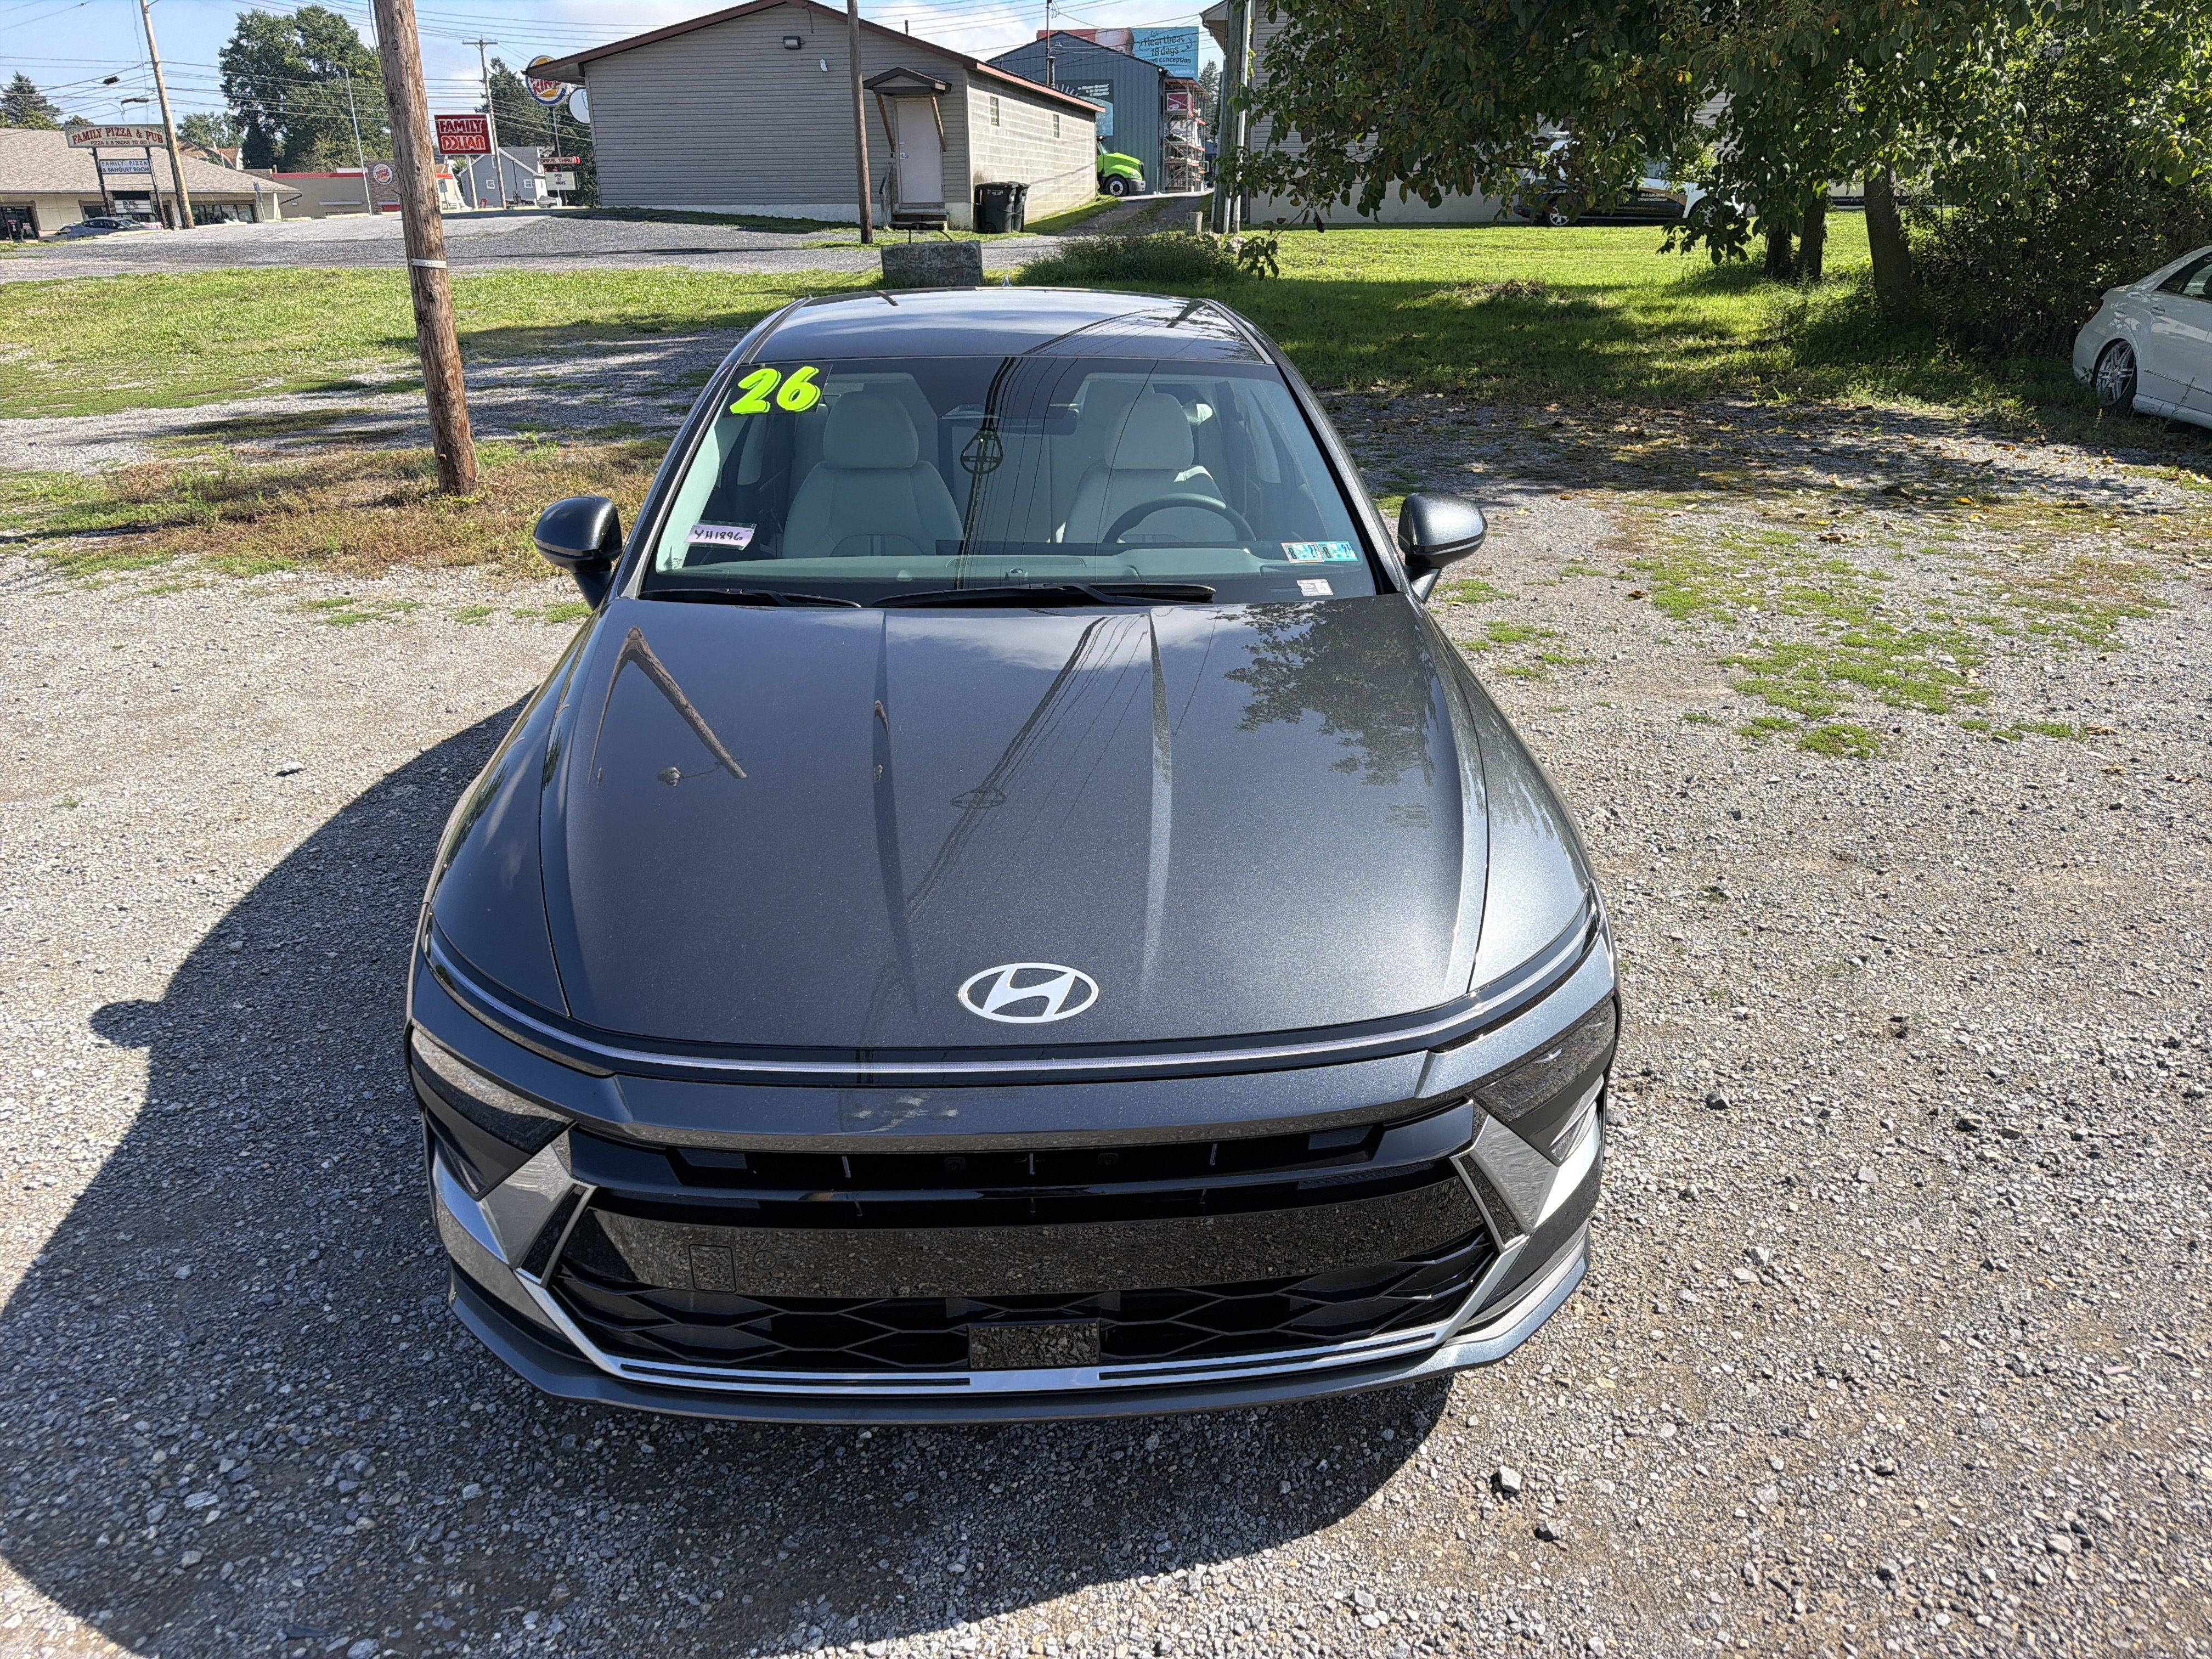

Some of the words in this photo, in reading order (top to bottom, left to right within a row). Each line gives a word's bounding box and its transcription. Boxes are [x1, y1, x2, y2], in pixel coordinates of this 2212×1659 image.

[1142, 35, 1185, 47] Heartbeat
[1150, 47, 1160, 57] 18
[1160, 46, 1179, 56] days
[438, 119, 483, 133] FAMILY
[72, 128, 102, 145] FAMILY
[105, 127, 133, 137] PIZZA
[136, 128, 143, 138] &
[144, 131, 163, 144] PUB
[441, 135, 486, 150] DOLLAR
[377, 171, 390, 179] KING
[730, 366, 821, 415] 26
[695, 529, 743, 540] YH1896
[1288, 548, 1297, 559] 8
[1323, 546, 1332, 558] 8
